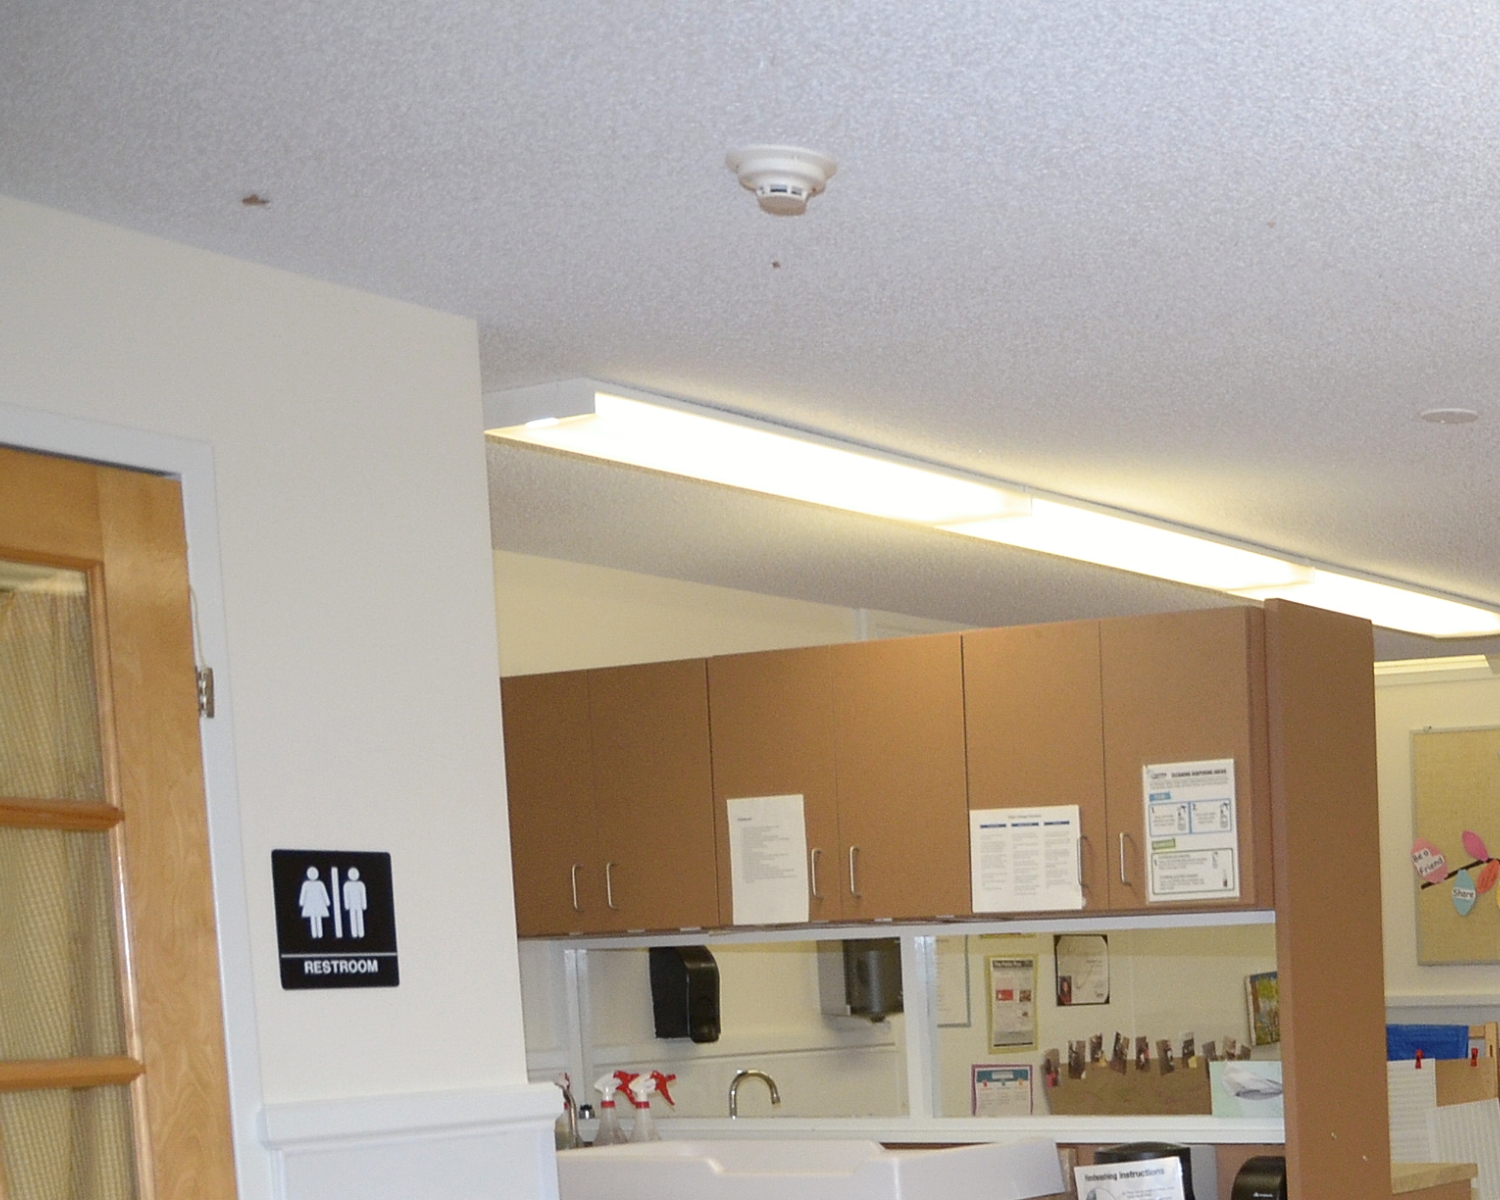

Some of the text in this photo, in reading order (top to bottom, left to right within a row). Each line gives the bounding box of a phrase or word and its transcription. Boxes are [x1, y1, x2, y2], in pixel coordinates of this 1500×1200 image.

[1419, 857, 1443, 875] Friend
[1453, 888, 1474, 899] Share
[304, 959, 378, 974] RESTROOM
